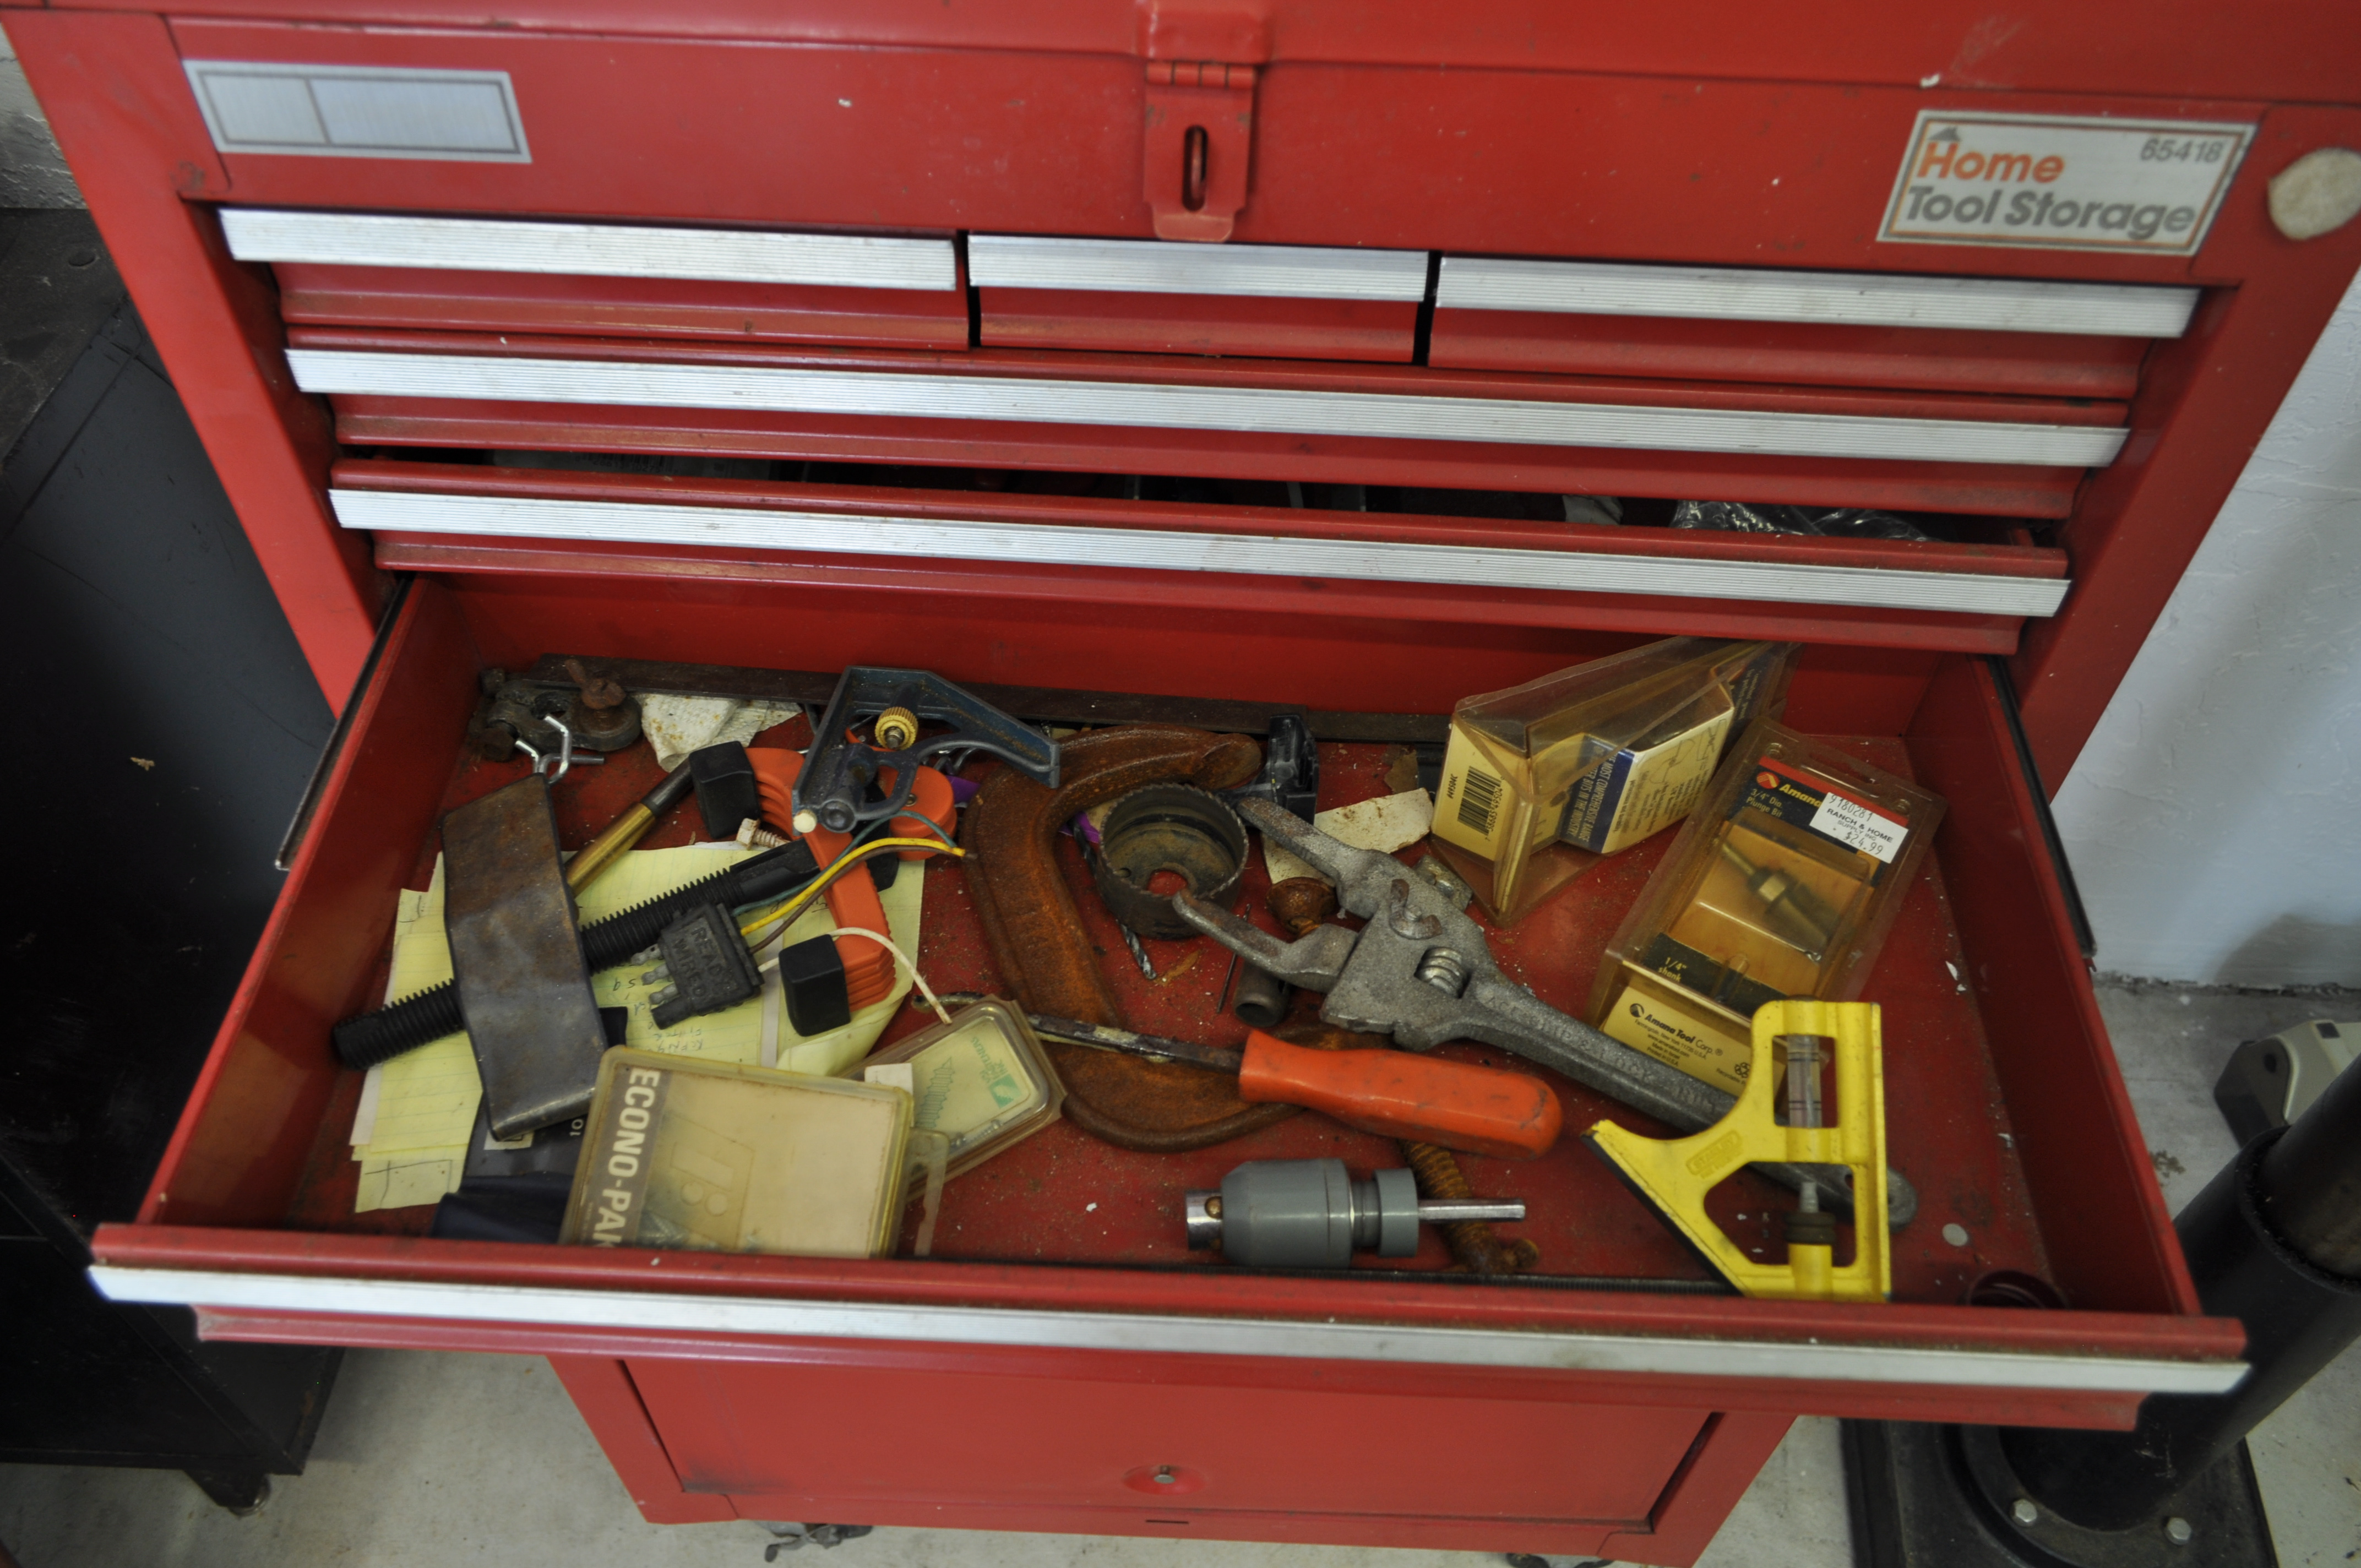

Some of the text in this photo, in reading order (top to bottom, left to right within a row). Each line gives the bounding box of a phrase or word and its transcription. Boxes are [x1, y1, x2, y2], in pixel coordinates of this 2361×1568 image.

[1916, 141, 2064, 183] Home
[2141, 138, 2224, 162] 65418
[1906, 186, 2195, 240] Tool Storage
[1598, 761, 1613, 780] MOST
[1578, 791, 1590, 800] IN
[1580, 778, 1593, 792] BITS
[1778, 781, 1823, 809] Amana
[1574, 798, 1587, 810] THE
[1584, 778, 1608, 824] COMPREHENSIVE
[1745, 796, 1783, 818] Plunge Bit
[1769, 796, 1785, 809] Dia.
[1577, 822, 1593, 842] RANGE
[1826, 808, 1858, 826] RANCH
[1867, 826, 1894, 843] HOME
[1837, 819, 1864, 835] SUPPLY
[1842, 829, 1884, 857] $24.99
[670, 937, 710, 999] WIRED
[690, 925, 733, 993] READY
[1657, 964, 1683, 982] shank
[1643, 1012, 1677, 1035] Amana
[1675, 1028, 1696, 1044] Tool
